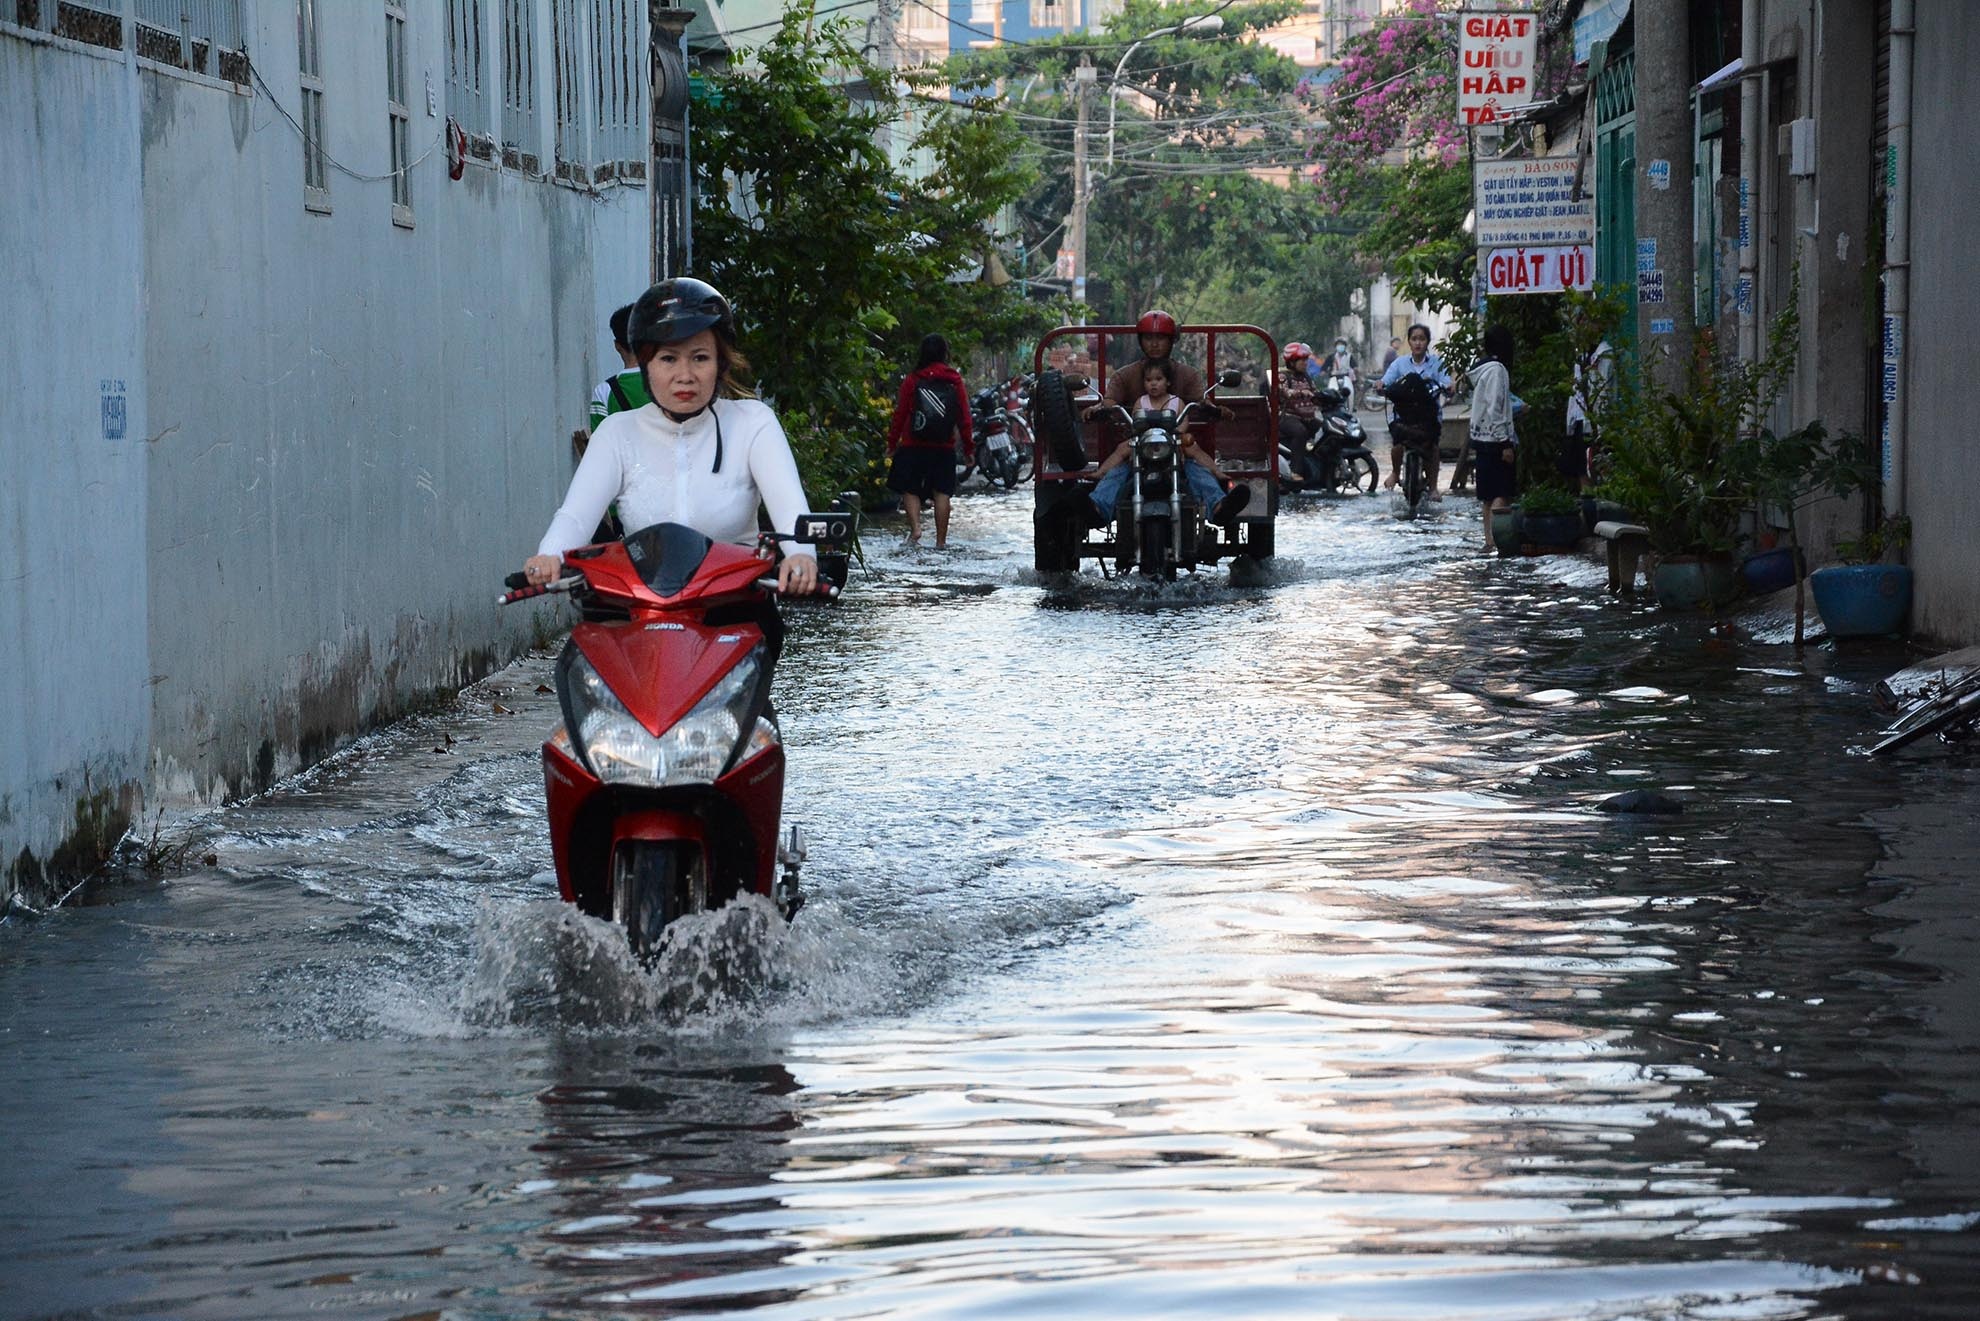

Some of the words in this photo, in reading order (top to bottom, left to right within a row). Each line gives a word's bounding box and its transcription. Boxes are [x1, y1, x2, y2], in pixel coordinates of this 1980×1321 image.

[1466, 13, 1530, 42] GIẶT
[1463, 70, 1526, 94] HẤP
[1490, 248, 1545, 291] GIẶT
[644, 622, 685, 631] HONDA
